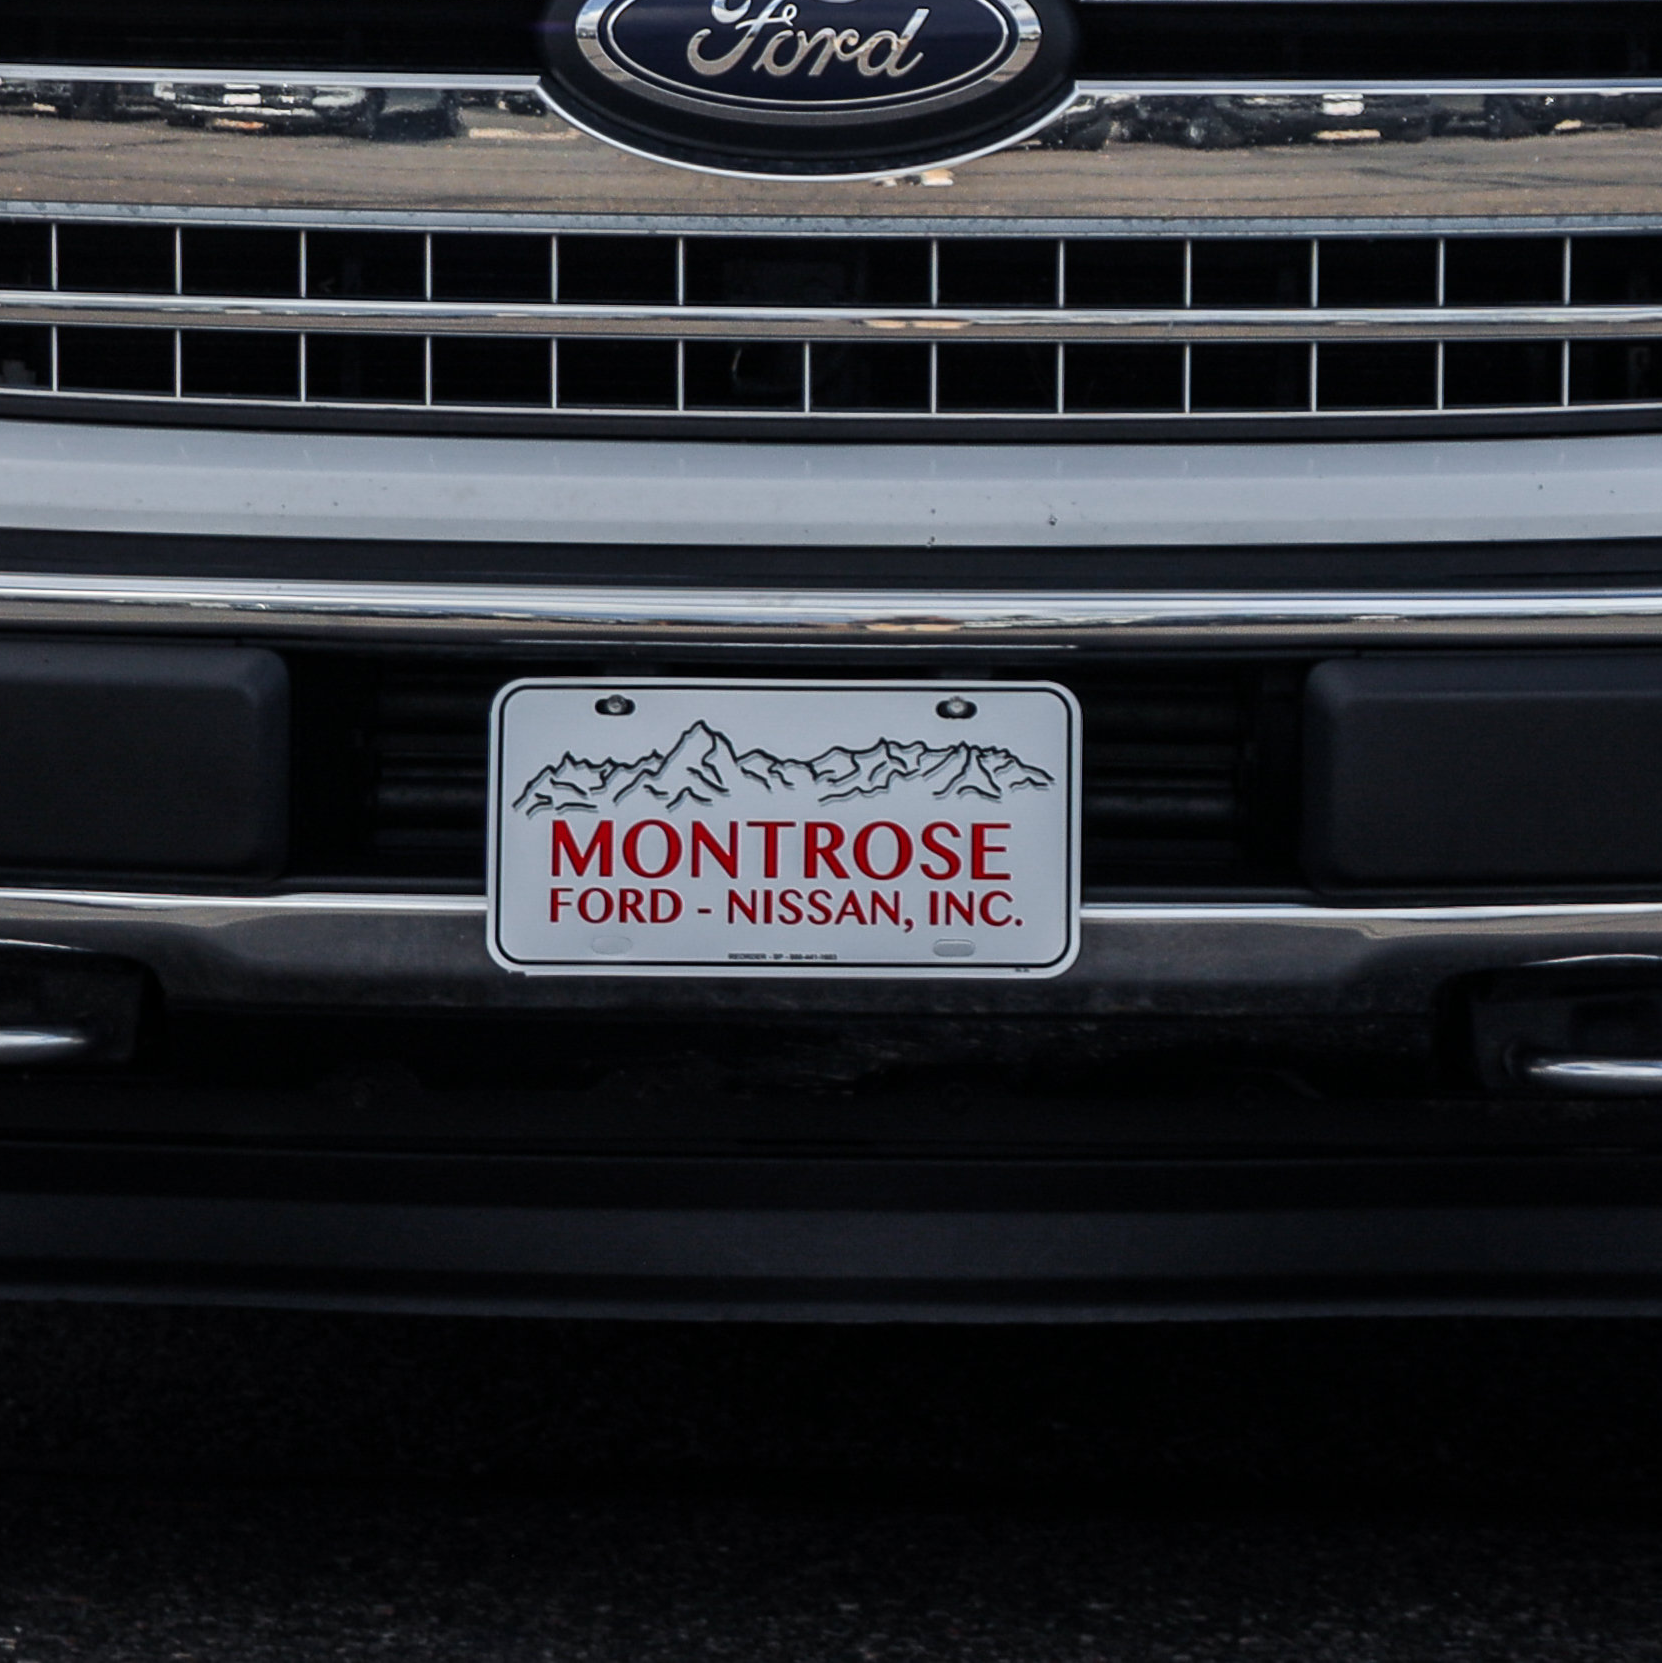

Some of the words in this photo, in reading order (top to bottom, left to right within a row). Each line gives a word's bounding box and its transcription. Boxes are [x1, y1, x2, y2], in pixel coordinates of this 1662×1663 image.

[548, 818, 1013, 882] MONTROSE
[548, 887, 685, 925] FORD
[727, 889, 915, 933] NISSAN,
[928, 890, 1025, 928] INC.
